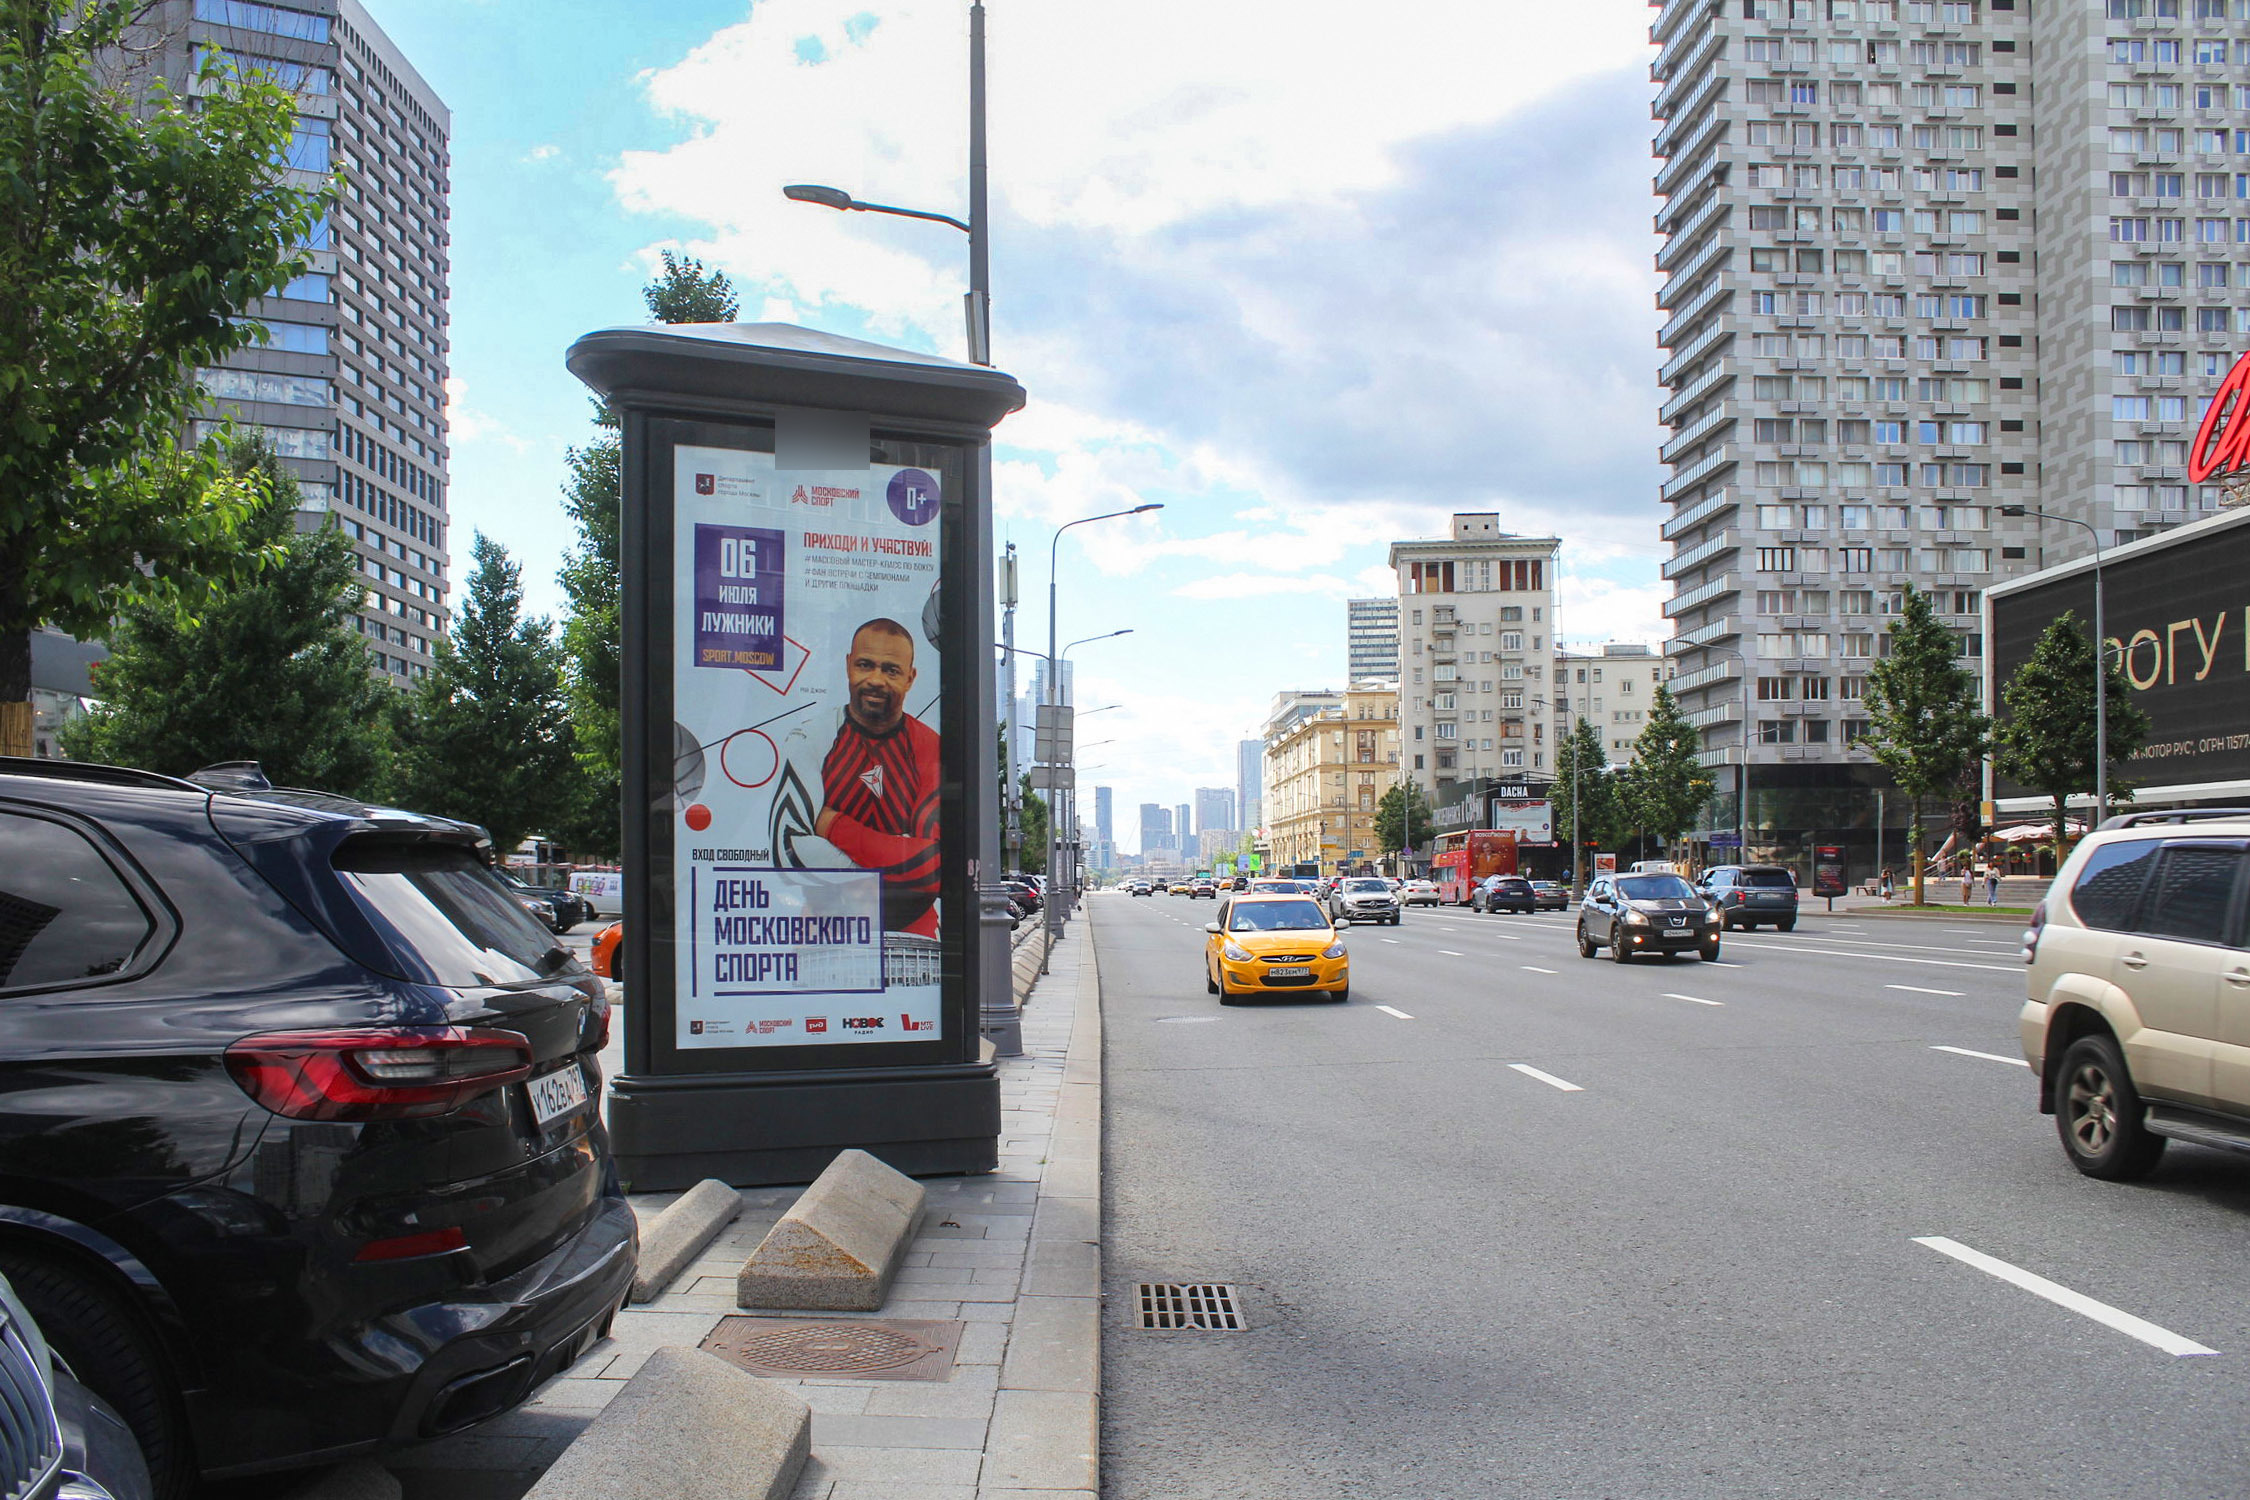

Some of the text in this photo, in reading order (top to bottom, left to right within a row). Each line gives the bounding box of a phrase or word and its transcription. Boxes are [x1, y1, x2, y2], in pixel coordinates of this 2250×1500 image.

[811, 486, 860, 500] МОСКОВСКИЙ
[811, 498, 834, 507] СПОРТ
[906, 487, 927, 511] 0+
[803, 532, 932, 557] ПРИХОДИ И УЧАСТВУЙ!
[721, 538, 756, 579] 06
[811, 580, 837, 589] ДРУГИЕ
[719, 585, 757, 605] ИЮЛЯ
[701, 611, 775, 636] ЛУЖНИКИ
[702, 649, 775, 665] SPORT.MOSCOW
[2199, 736, 2225, 753] ОГРН
[1501, 786, 1529, 798] DACHA
[692, 848, 770, 862] ВХОД СВОБОДНЫЙ
[713, 879, 769, 912] ДЕНЬ
[714, 916, 871, 945] МОСКОВСКОГО
[715, 953, 798, 982] СПОРТА
